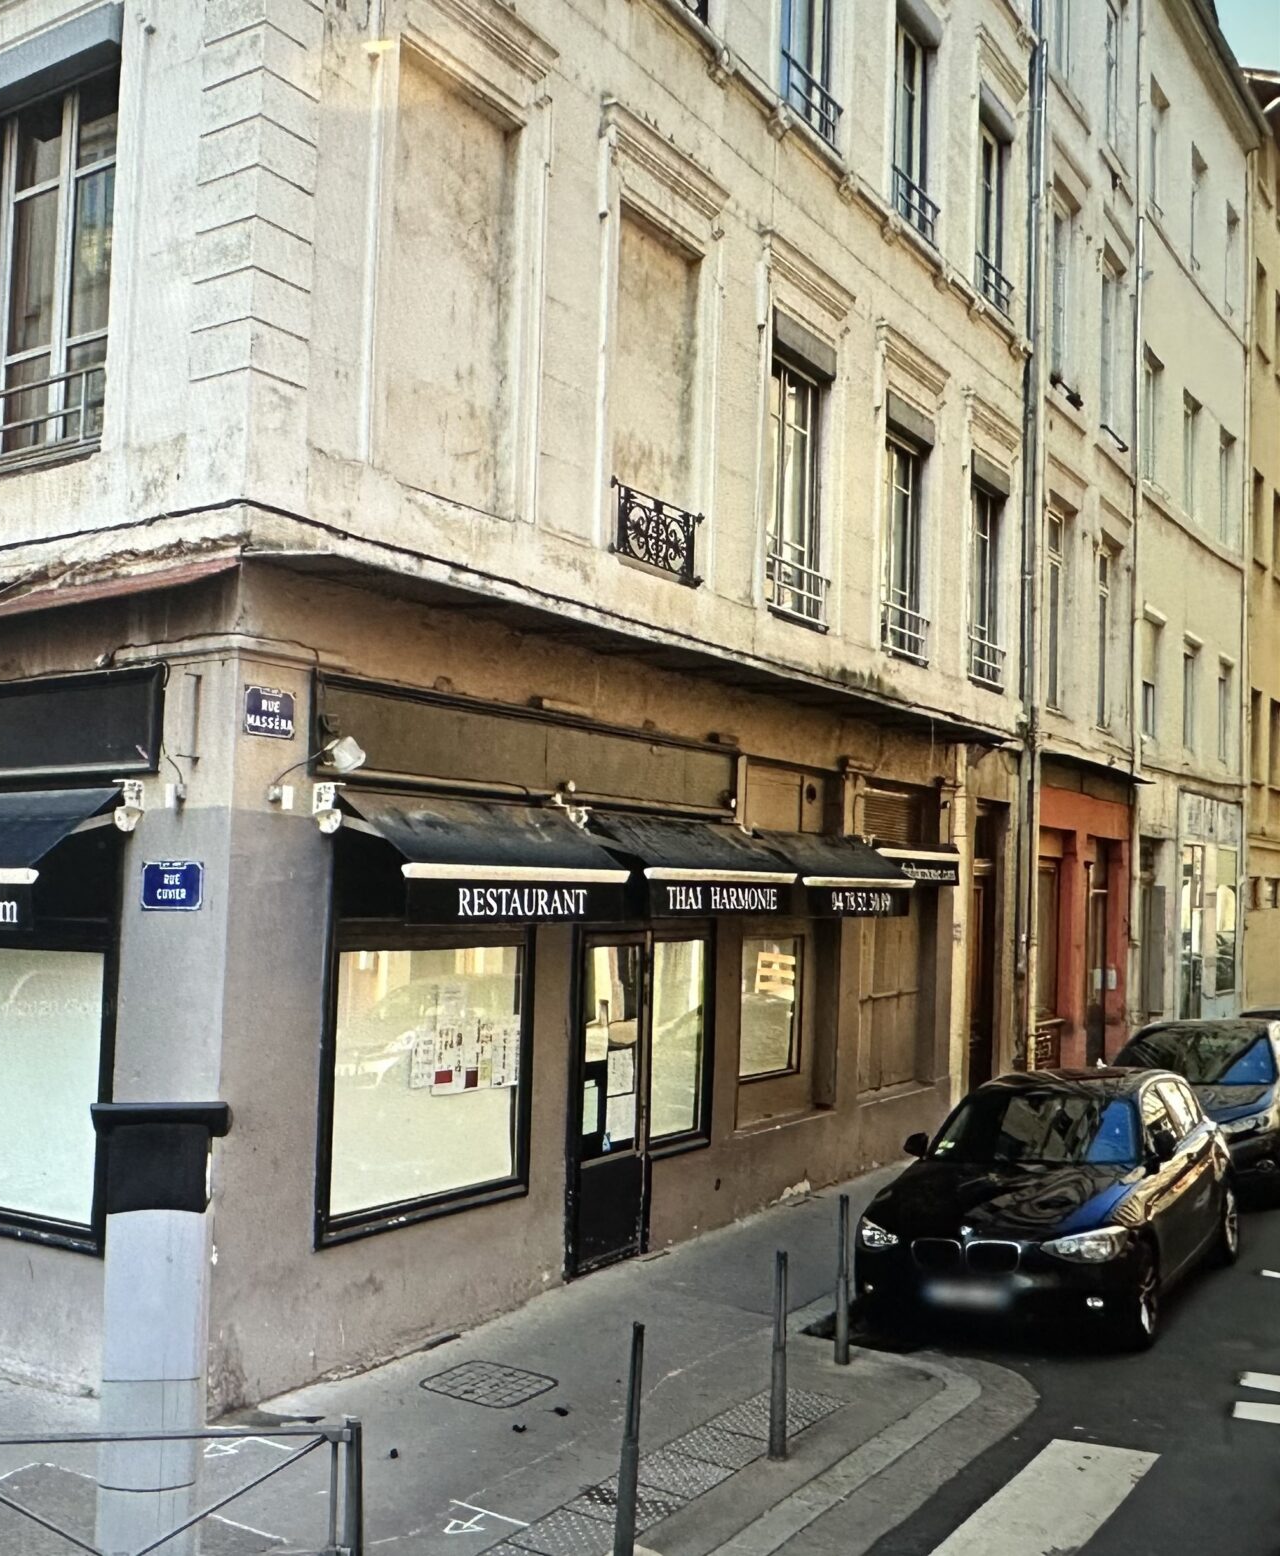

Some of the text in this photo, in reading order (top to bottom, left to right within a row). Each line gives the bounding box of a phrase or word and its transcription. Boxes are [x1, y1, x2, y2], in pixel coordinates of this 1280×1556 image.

[261, 699, 280, 713] RUE
[163, 873, 181, 885] RUE
[156, 888, 187, 900] CUVIER
[666, 886, 778, 910] THAI HARMONIE
[457, 887, 587, 917] RESTAURANT
